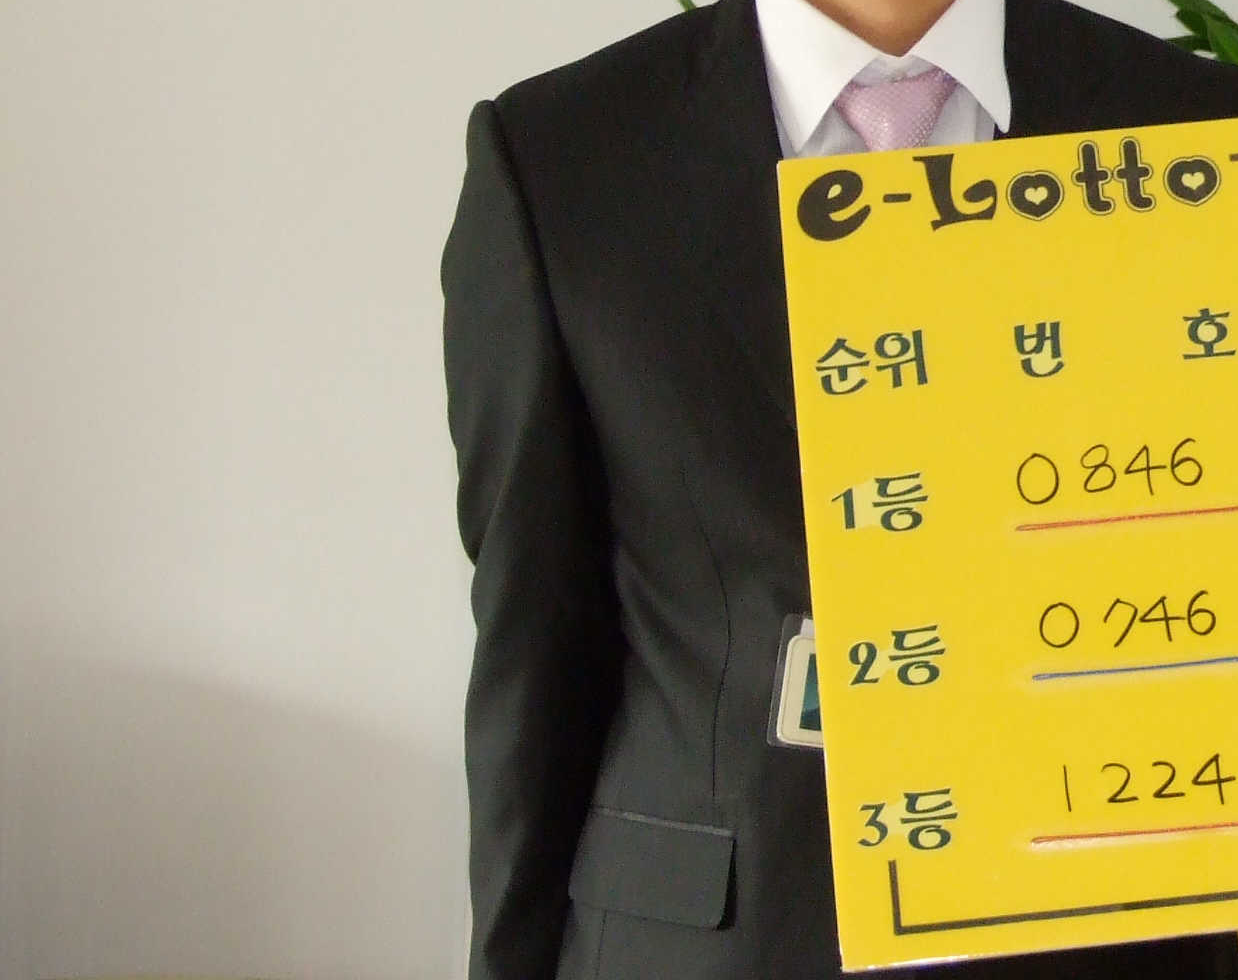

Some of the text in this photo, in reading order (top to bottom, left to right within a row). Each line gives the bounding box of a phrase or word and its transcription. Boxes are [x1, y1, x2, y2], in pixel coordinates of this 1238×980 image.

[796, 136, 1222, 242] e-Lotto
[814, 329, 929, 396] 순위
[830, 472, 929, 533] 1등
[1015, 437, 1204, 505] 0846
[847, 624, 946, 687] 2등
[1062, 753, 1237, 813] 1224
[857, 787, 959, 851] 3등
